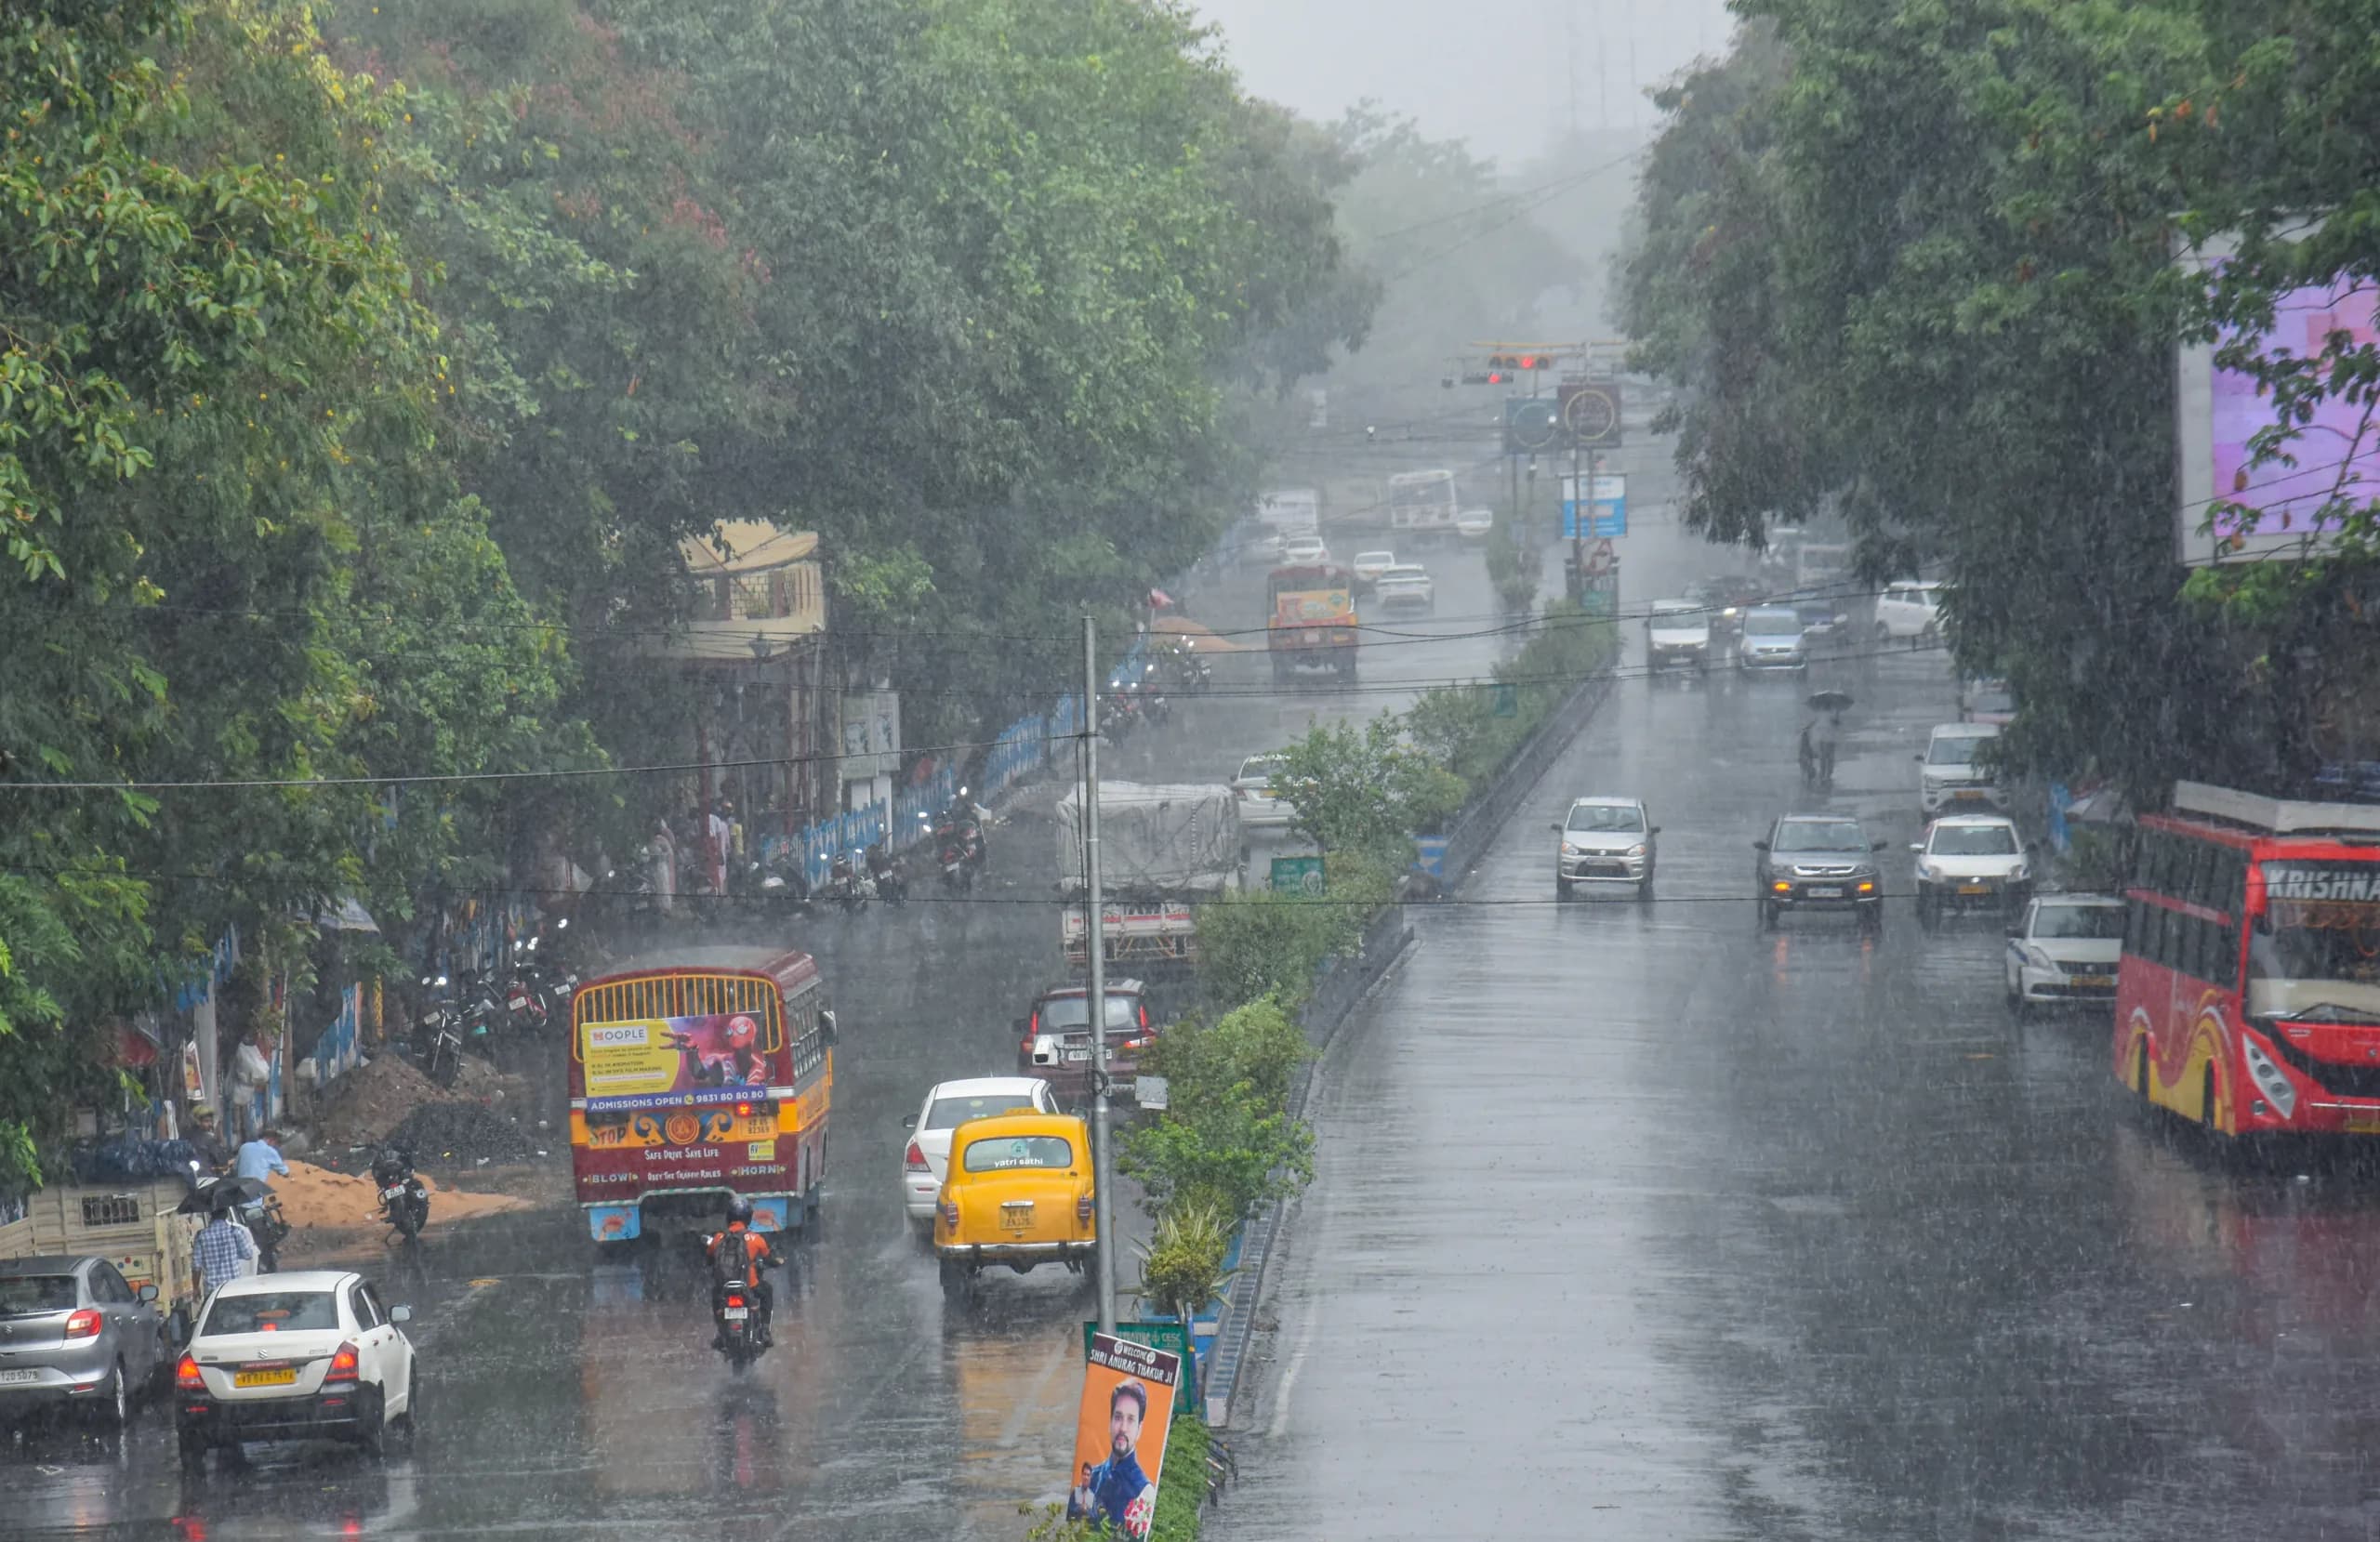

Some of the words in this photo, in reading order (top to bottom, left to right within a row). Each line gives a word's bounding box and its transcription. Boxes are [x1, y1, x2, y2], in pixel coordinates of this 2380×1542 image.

[591, 1099, 653, 1110] ADMISSIONS
[654, 1097, 682, 1106] OPEN
[695, 1094, 718, 1103] 9831
[721, 1092, 733, 1100] 80
[735, 1091, 748, 1100] 80
[751, 1090, 763, 1099] 80
[644, 1150, 662, 1160] SAFE
[664, 1150, 682, 1161] DRIVE
[685, 1147, 702, 1158] SAVE
[704, 1148, 720, 1157] LIFE
[995, 1158, 1017, 1167] yatri
[1019, 1157, 1043, 1166] sathi
[700, 1169, 721, 1178] RULES
[741, 1166, 776, 1175] HORN
[592, 1174, 628, 1183] BLOW
[1122, 1344, 1147, 1360] WELCOME
[1090, 1349, 1107, 1364] SHRI
[1108, 1354, 1136, 1373] ANURAG
[1137, 1364, 1164, 1381] THAKUR
[1165, 1370, 1173, 1384] JI
